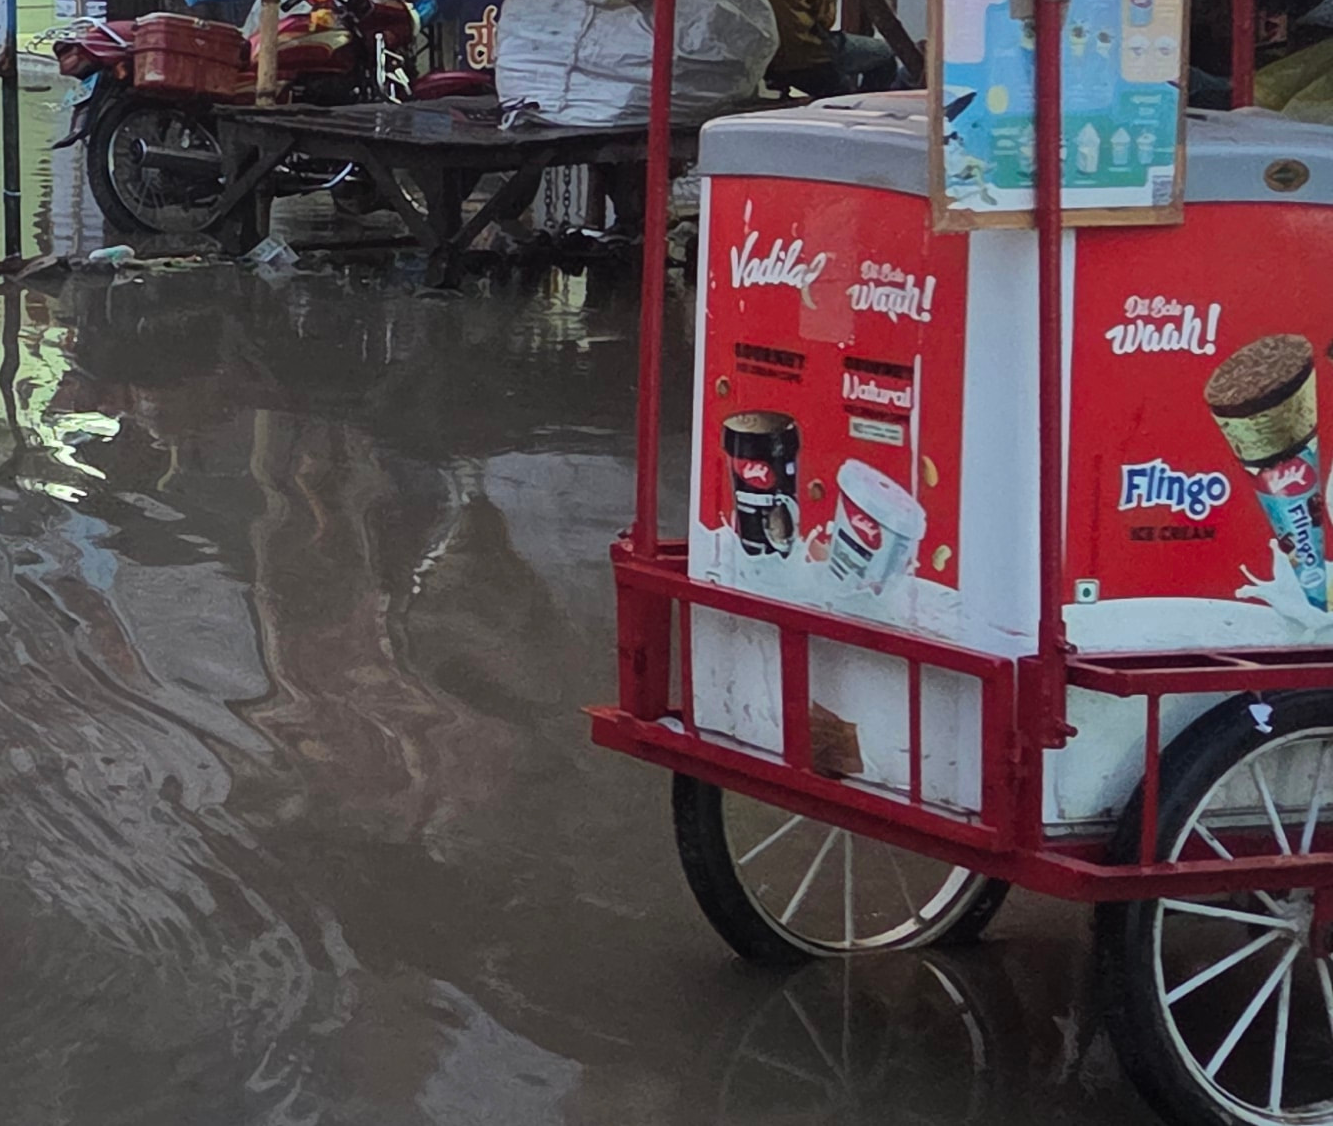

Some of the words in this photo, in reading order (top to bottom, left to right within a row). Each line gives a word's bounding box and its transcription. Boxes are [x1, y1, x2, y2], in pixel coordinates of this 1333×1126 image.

[1105, 303, 1221, 355] waah!
[842, 372, 912, 408] Natural
[1120, 460, 1229, 520] Flingo
[1288, 503, 1317, 568] Flingo
